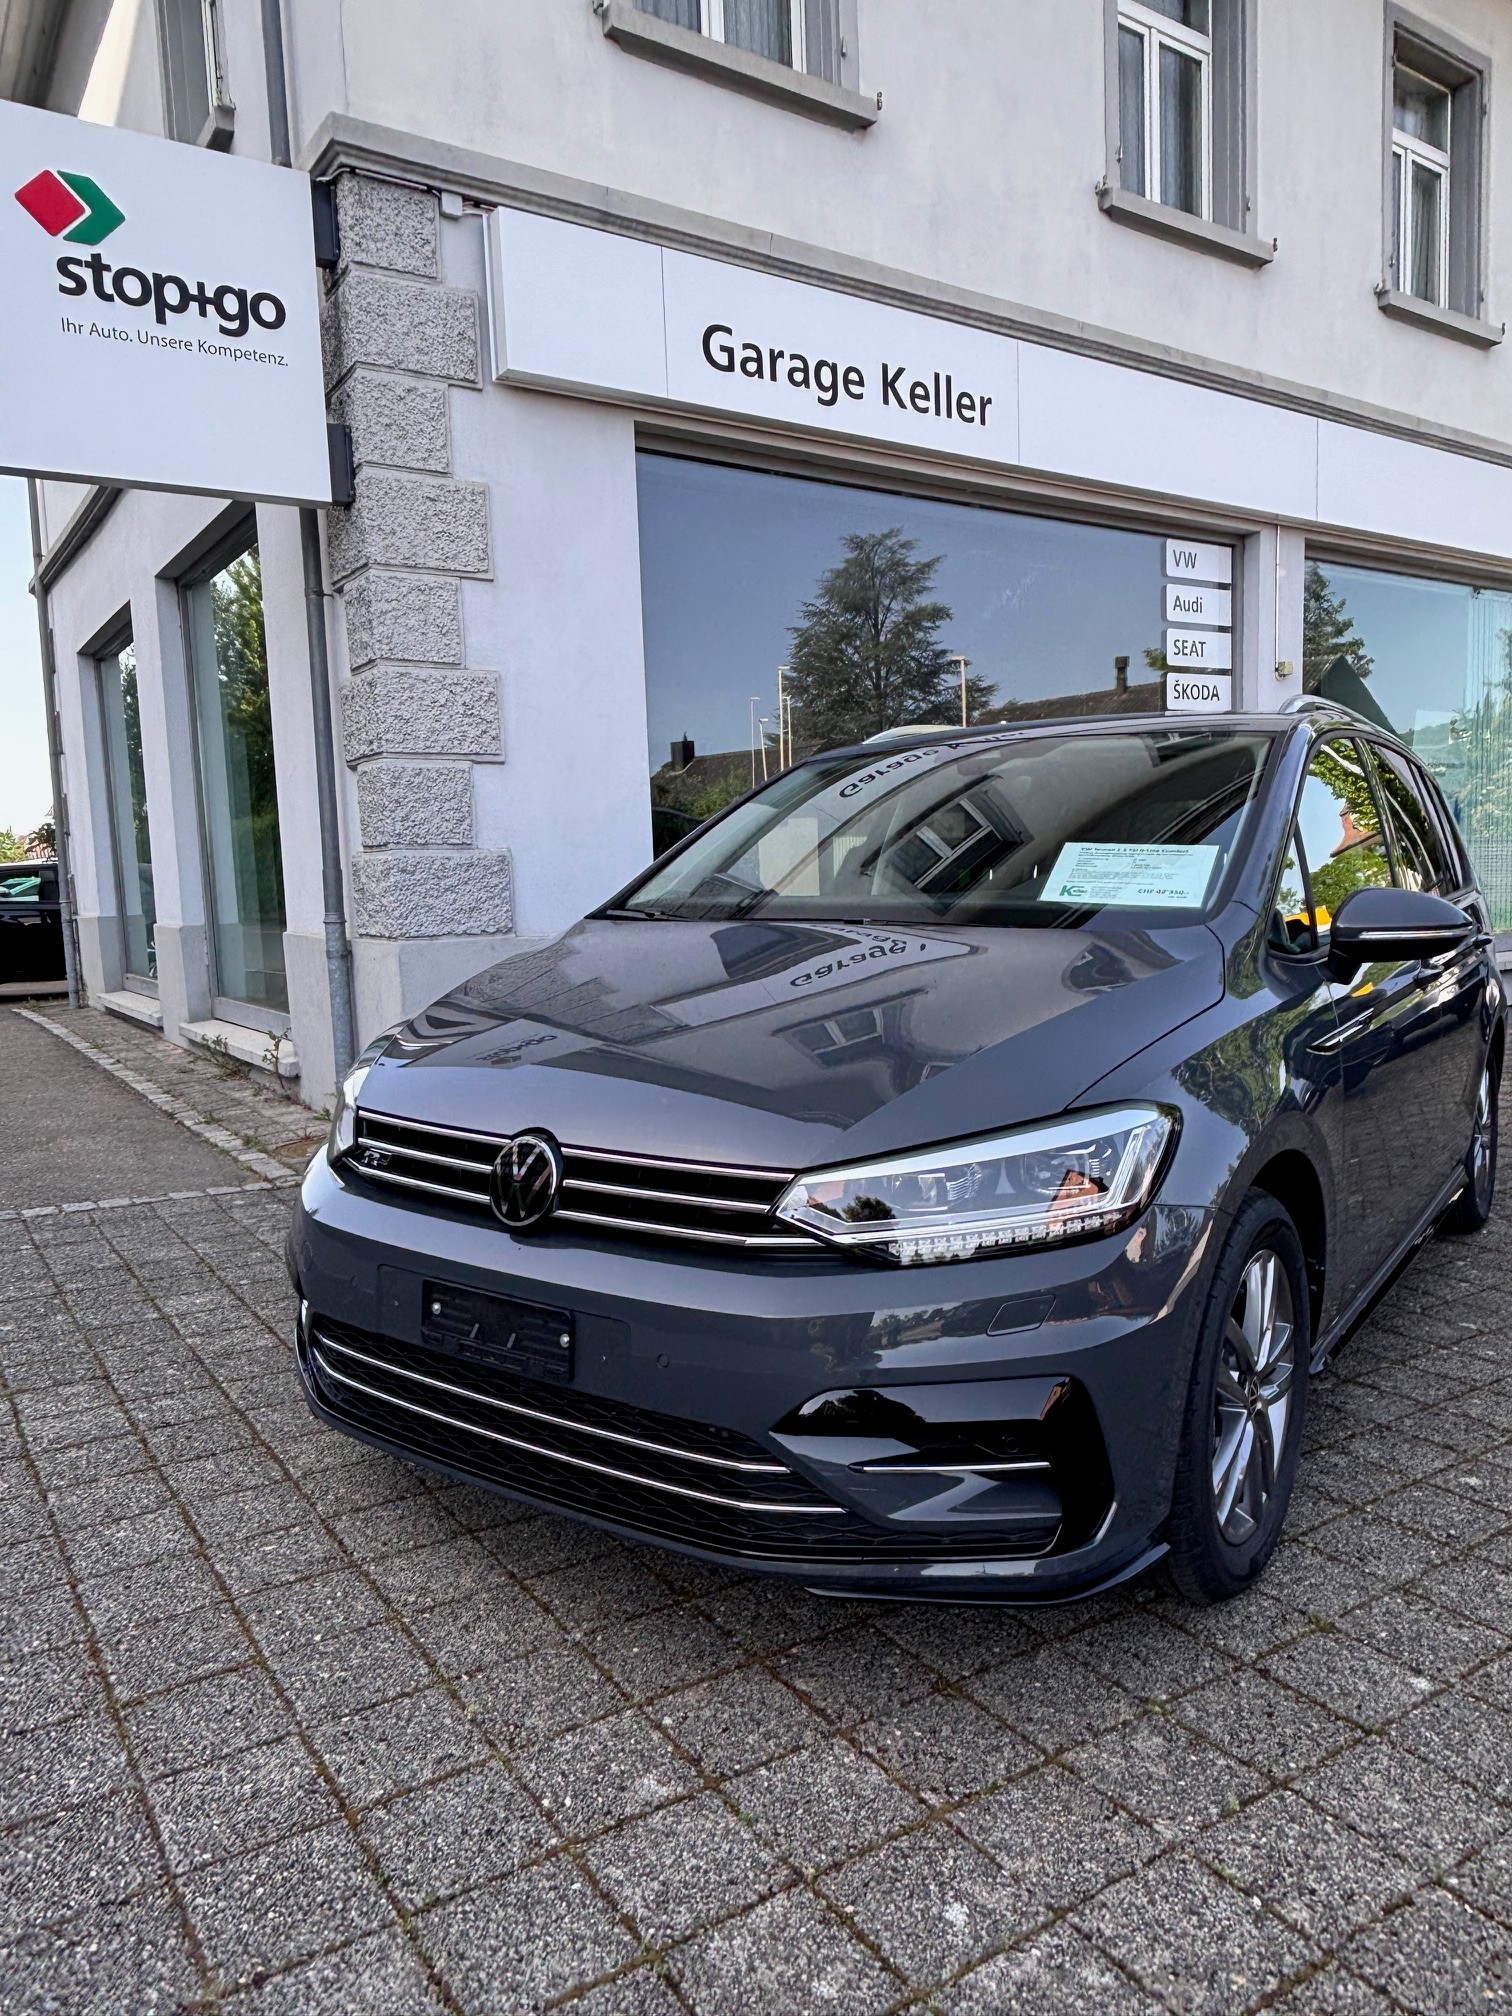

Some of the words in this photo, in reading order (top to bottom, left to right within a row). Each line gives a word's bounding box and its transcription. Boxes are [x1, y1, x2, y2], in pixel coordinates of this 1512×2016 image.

[56, 252, 287, 338] stop+go
[61, 317, 84, 336] Ihr
[89, 321, 134, 343] Auto.
[137, 330, 194, 353] Unsere
[197, 338, 289, 367] Kompetenz.
[702, 323, 865, 407] Garage
[881, 362, 992, 427] Keller
[1173, 549, 1198, 570] VW
[1173, 595, 1203, 614] Audi
[1173, 638, 1207, 658] SEAT
[1173, 679, 1220, 702] ŠKODA
